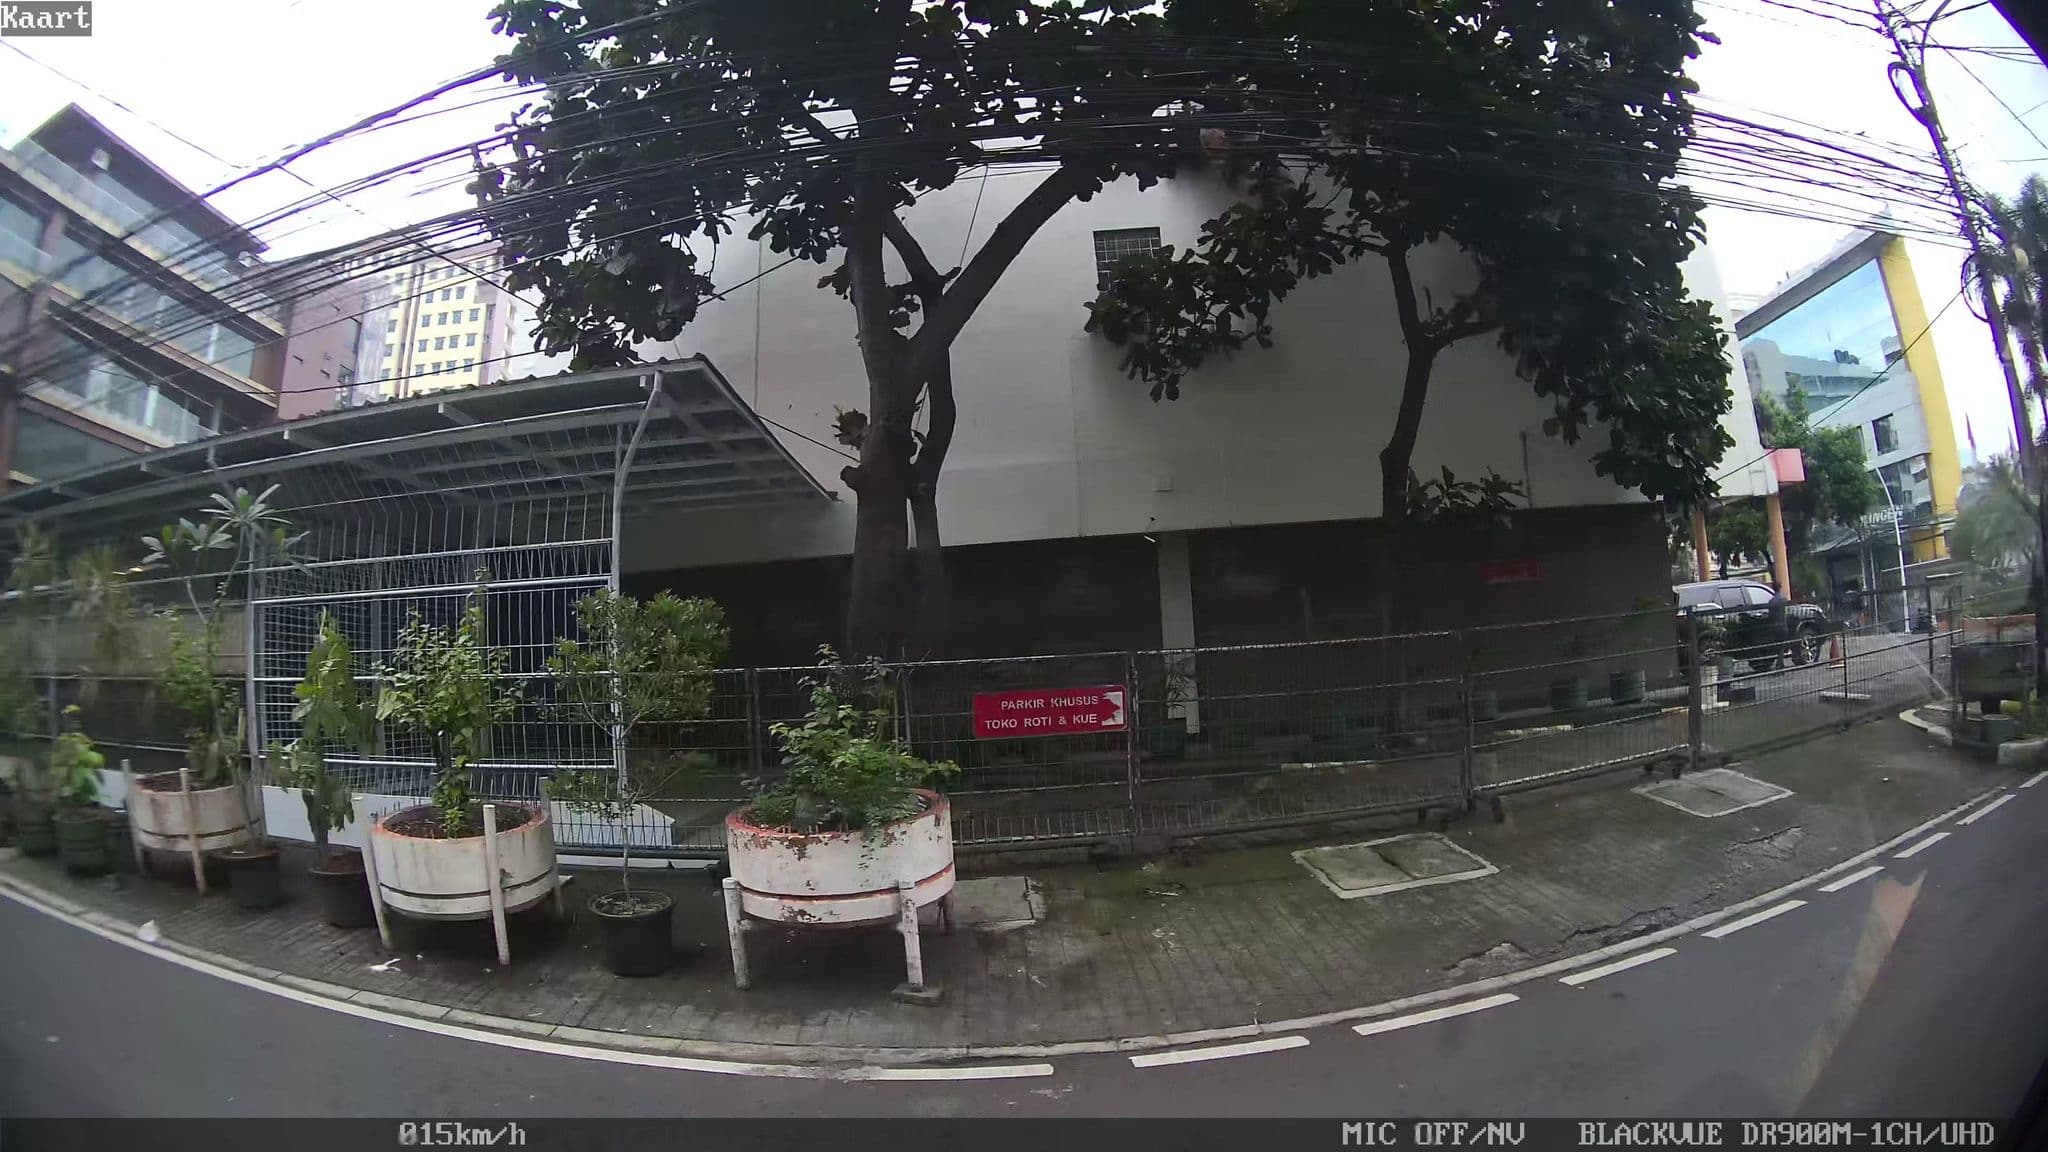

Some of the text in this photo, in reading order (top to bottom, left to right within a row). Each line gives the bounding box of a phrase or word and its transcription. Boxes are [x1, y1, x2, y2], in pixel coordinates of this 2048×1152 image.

[1001, 695, 1098, 710] PARKIR KHUSUS
[985, 713, 1097, 729] TOKO ROTI & KUE
